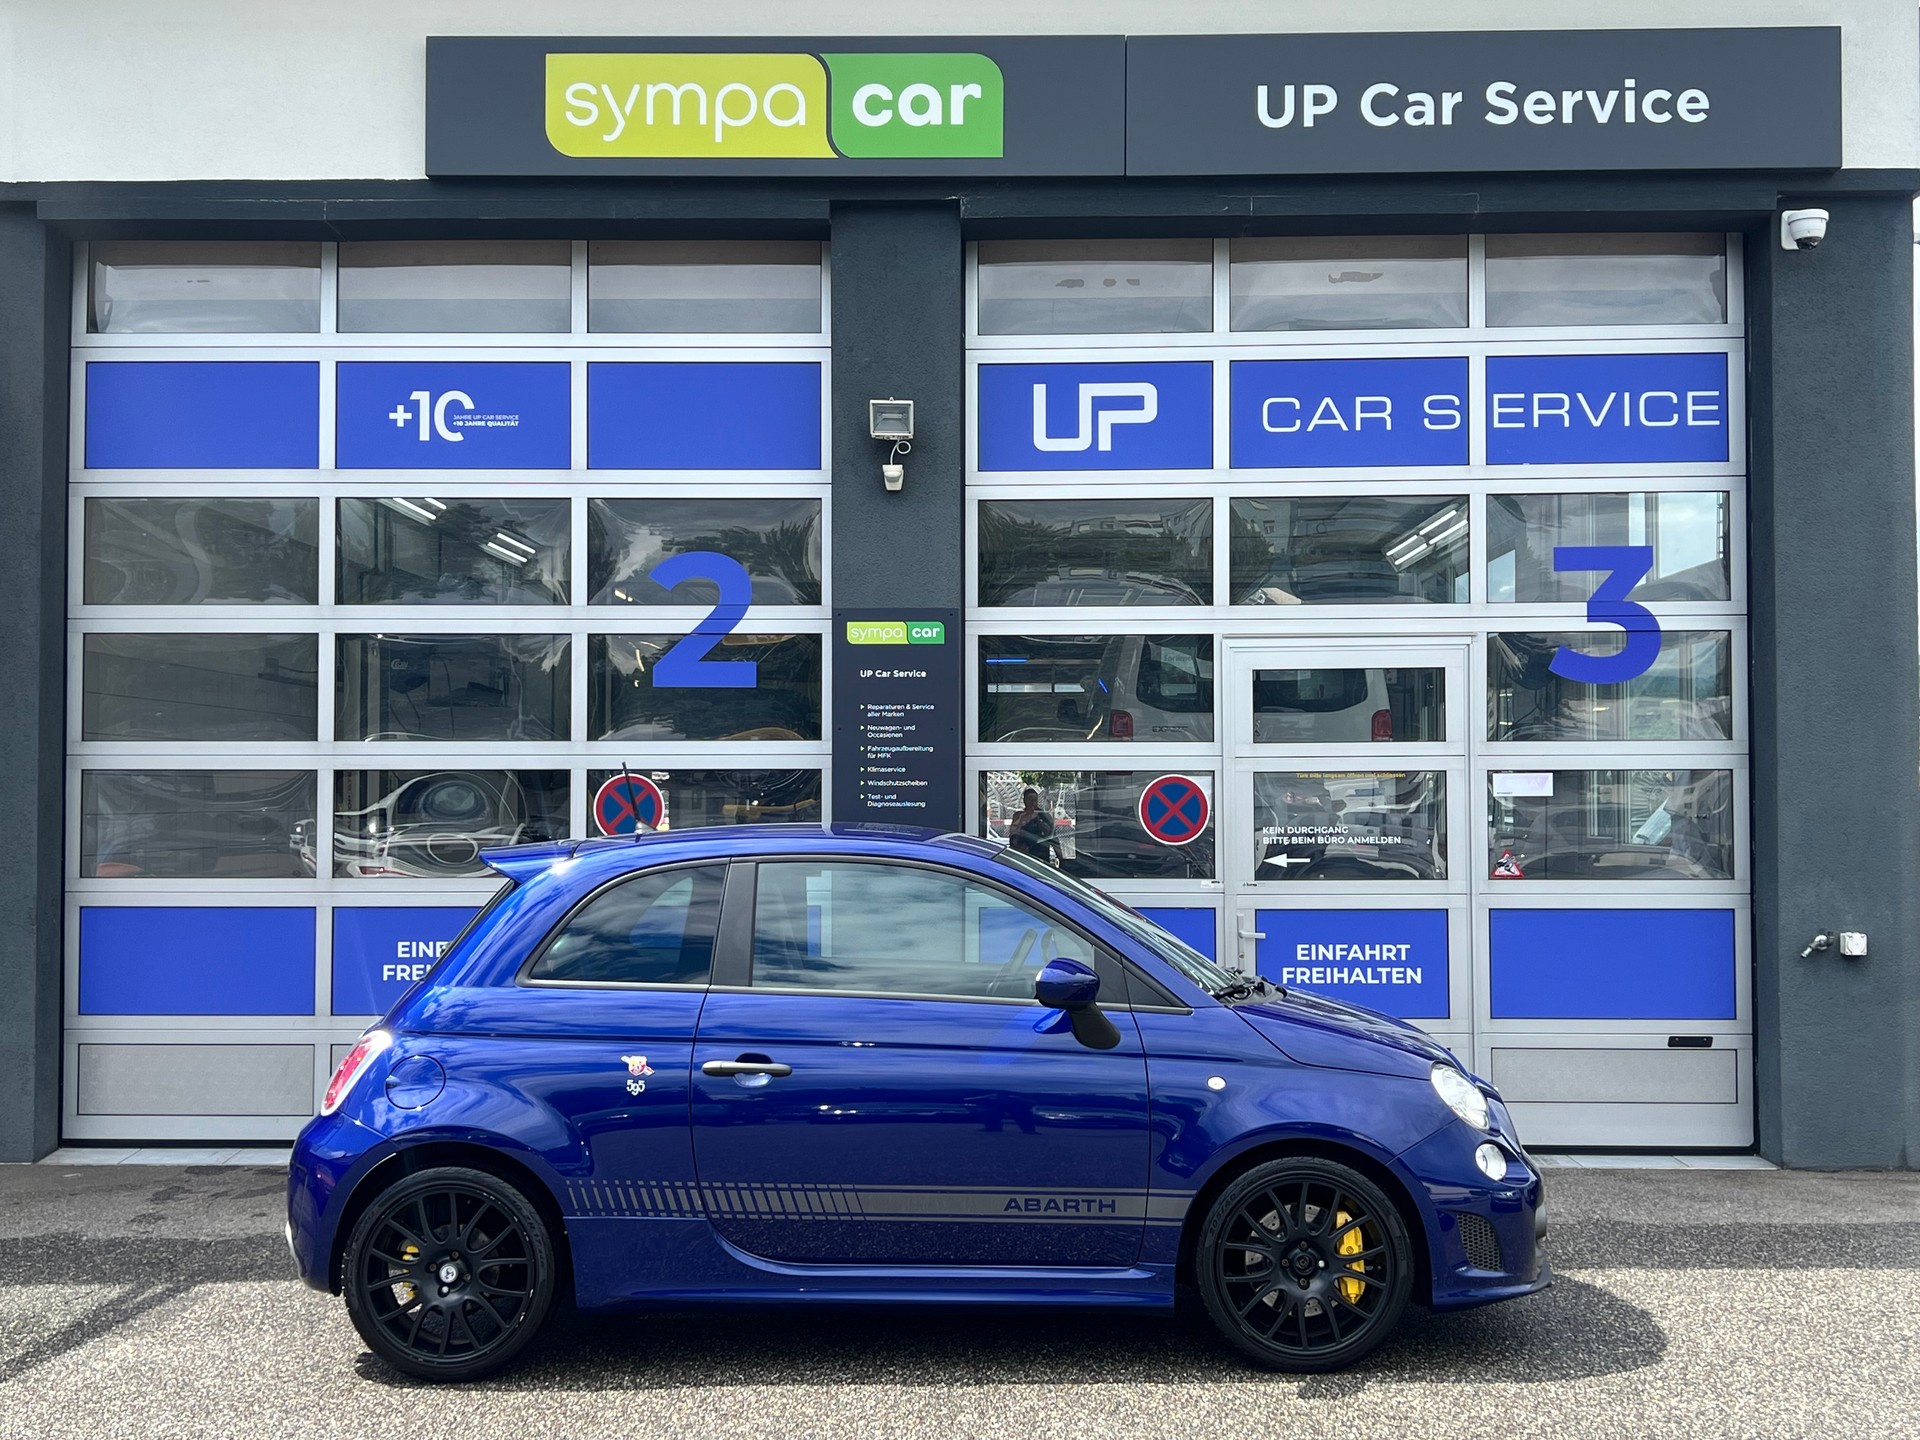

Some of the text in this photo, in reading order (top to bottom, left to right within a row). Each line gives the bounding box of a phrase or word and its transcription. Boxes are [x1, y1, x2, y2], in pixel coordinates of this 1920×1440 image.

[1256, 78, 1710, 128] UP Car Service
[563, 81, 982, 143] sympa car
[1033, 382, 1159, 452] UP
[1261, 395, 1394, 434] CAR
[648, 550, 758, 688] 2
[1548, 545, 1662, 685] 3
[850, 626, 940, 641] sympa car
[860, 670, 927, 678] UP Car Service
[1263, 826, 1349, 835] KEIN DURCHGANG
[1263, 835, 1402, 845] BITTE BEIM BÜRO ANMELDEN
[397, 941, 450, 958] EINF
[1296, 944, 1411, 961] EINFAHRT
[1282, 967, 1422, 984] FREIHALTEN
[626, 1079, 646, 1096] 595
[1003, 1197, 1116, 1213] ABARTH
